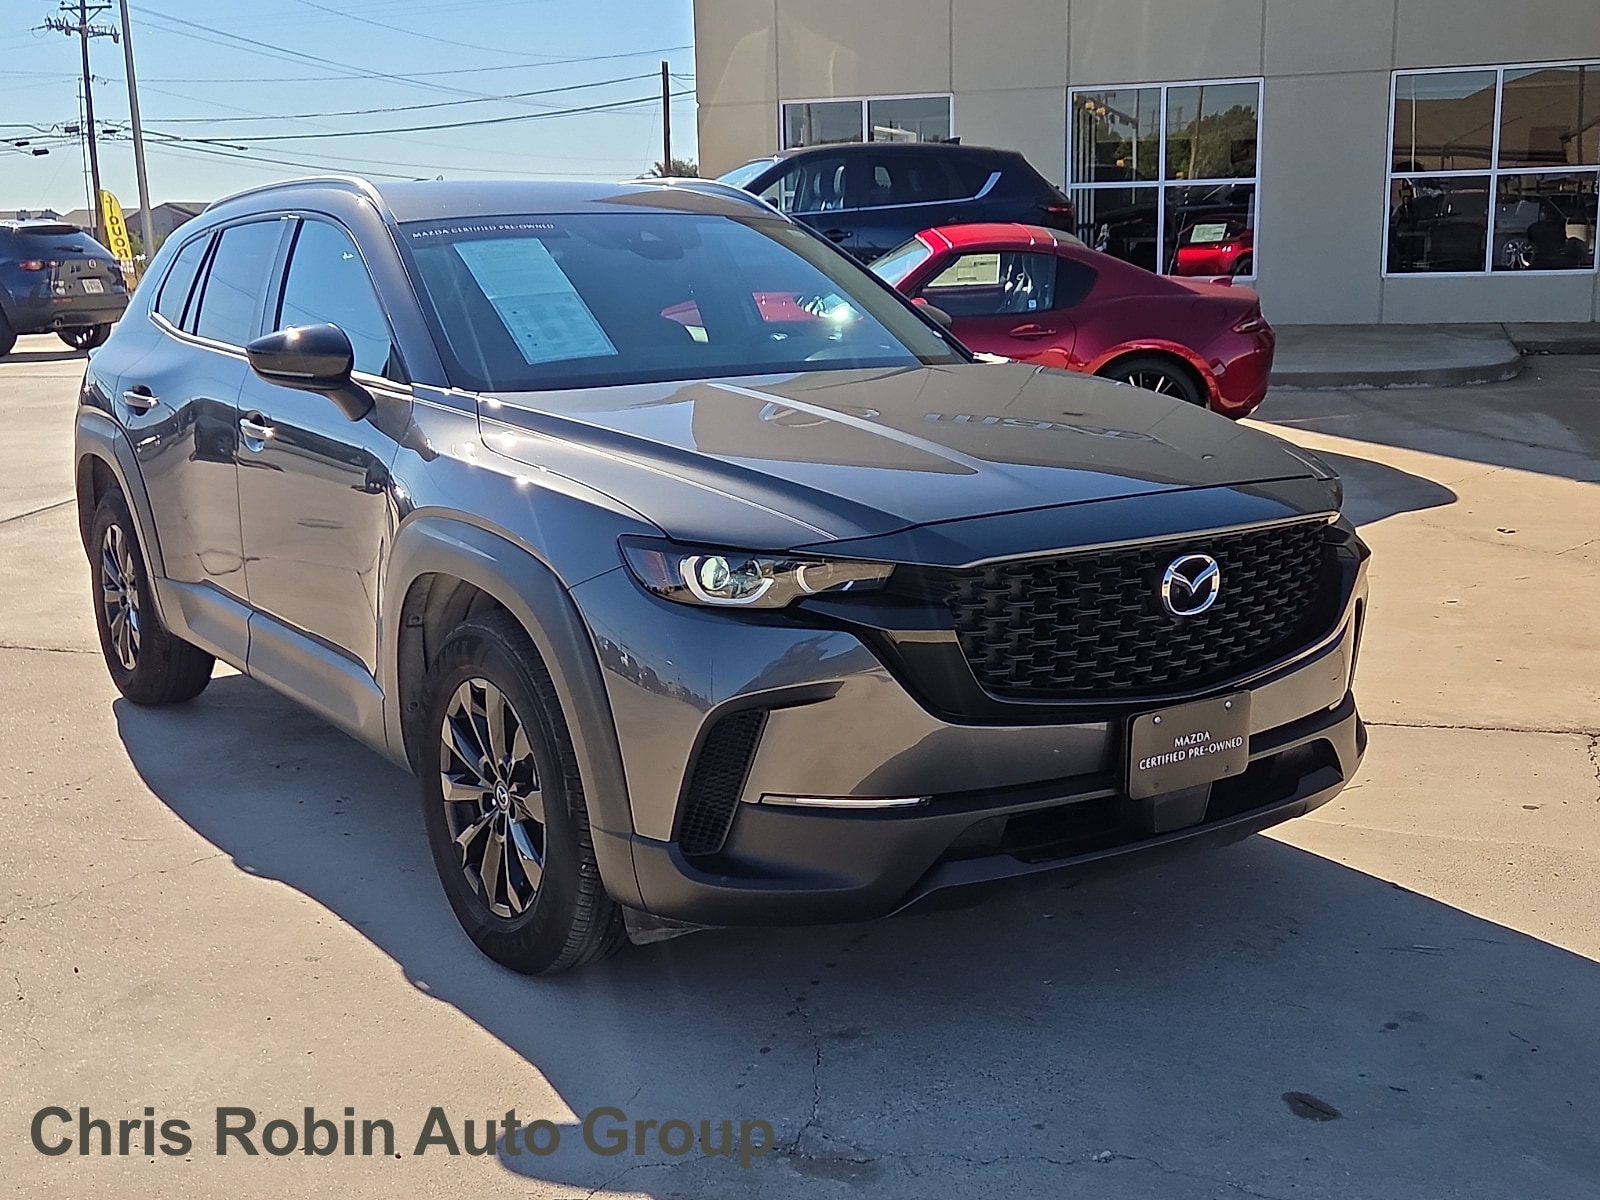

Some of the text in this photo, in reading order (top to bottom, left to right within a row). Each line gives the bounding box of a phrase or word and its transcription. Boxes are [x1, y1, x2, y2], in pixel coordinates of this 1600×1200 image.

[412, 223, 555, 239] MAZDA CERTIFIED PRE-OWNED
[1174, 731, 1211, 748] MAZDA
[1139, 736, 1243, 770] CERTIFIED PRE-OWNED
